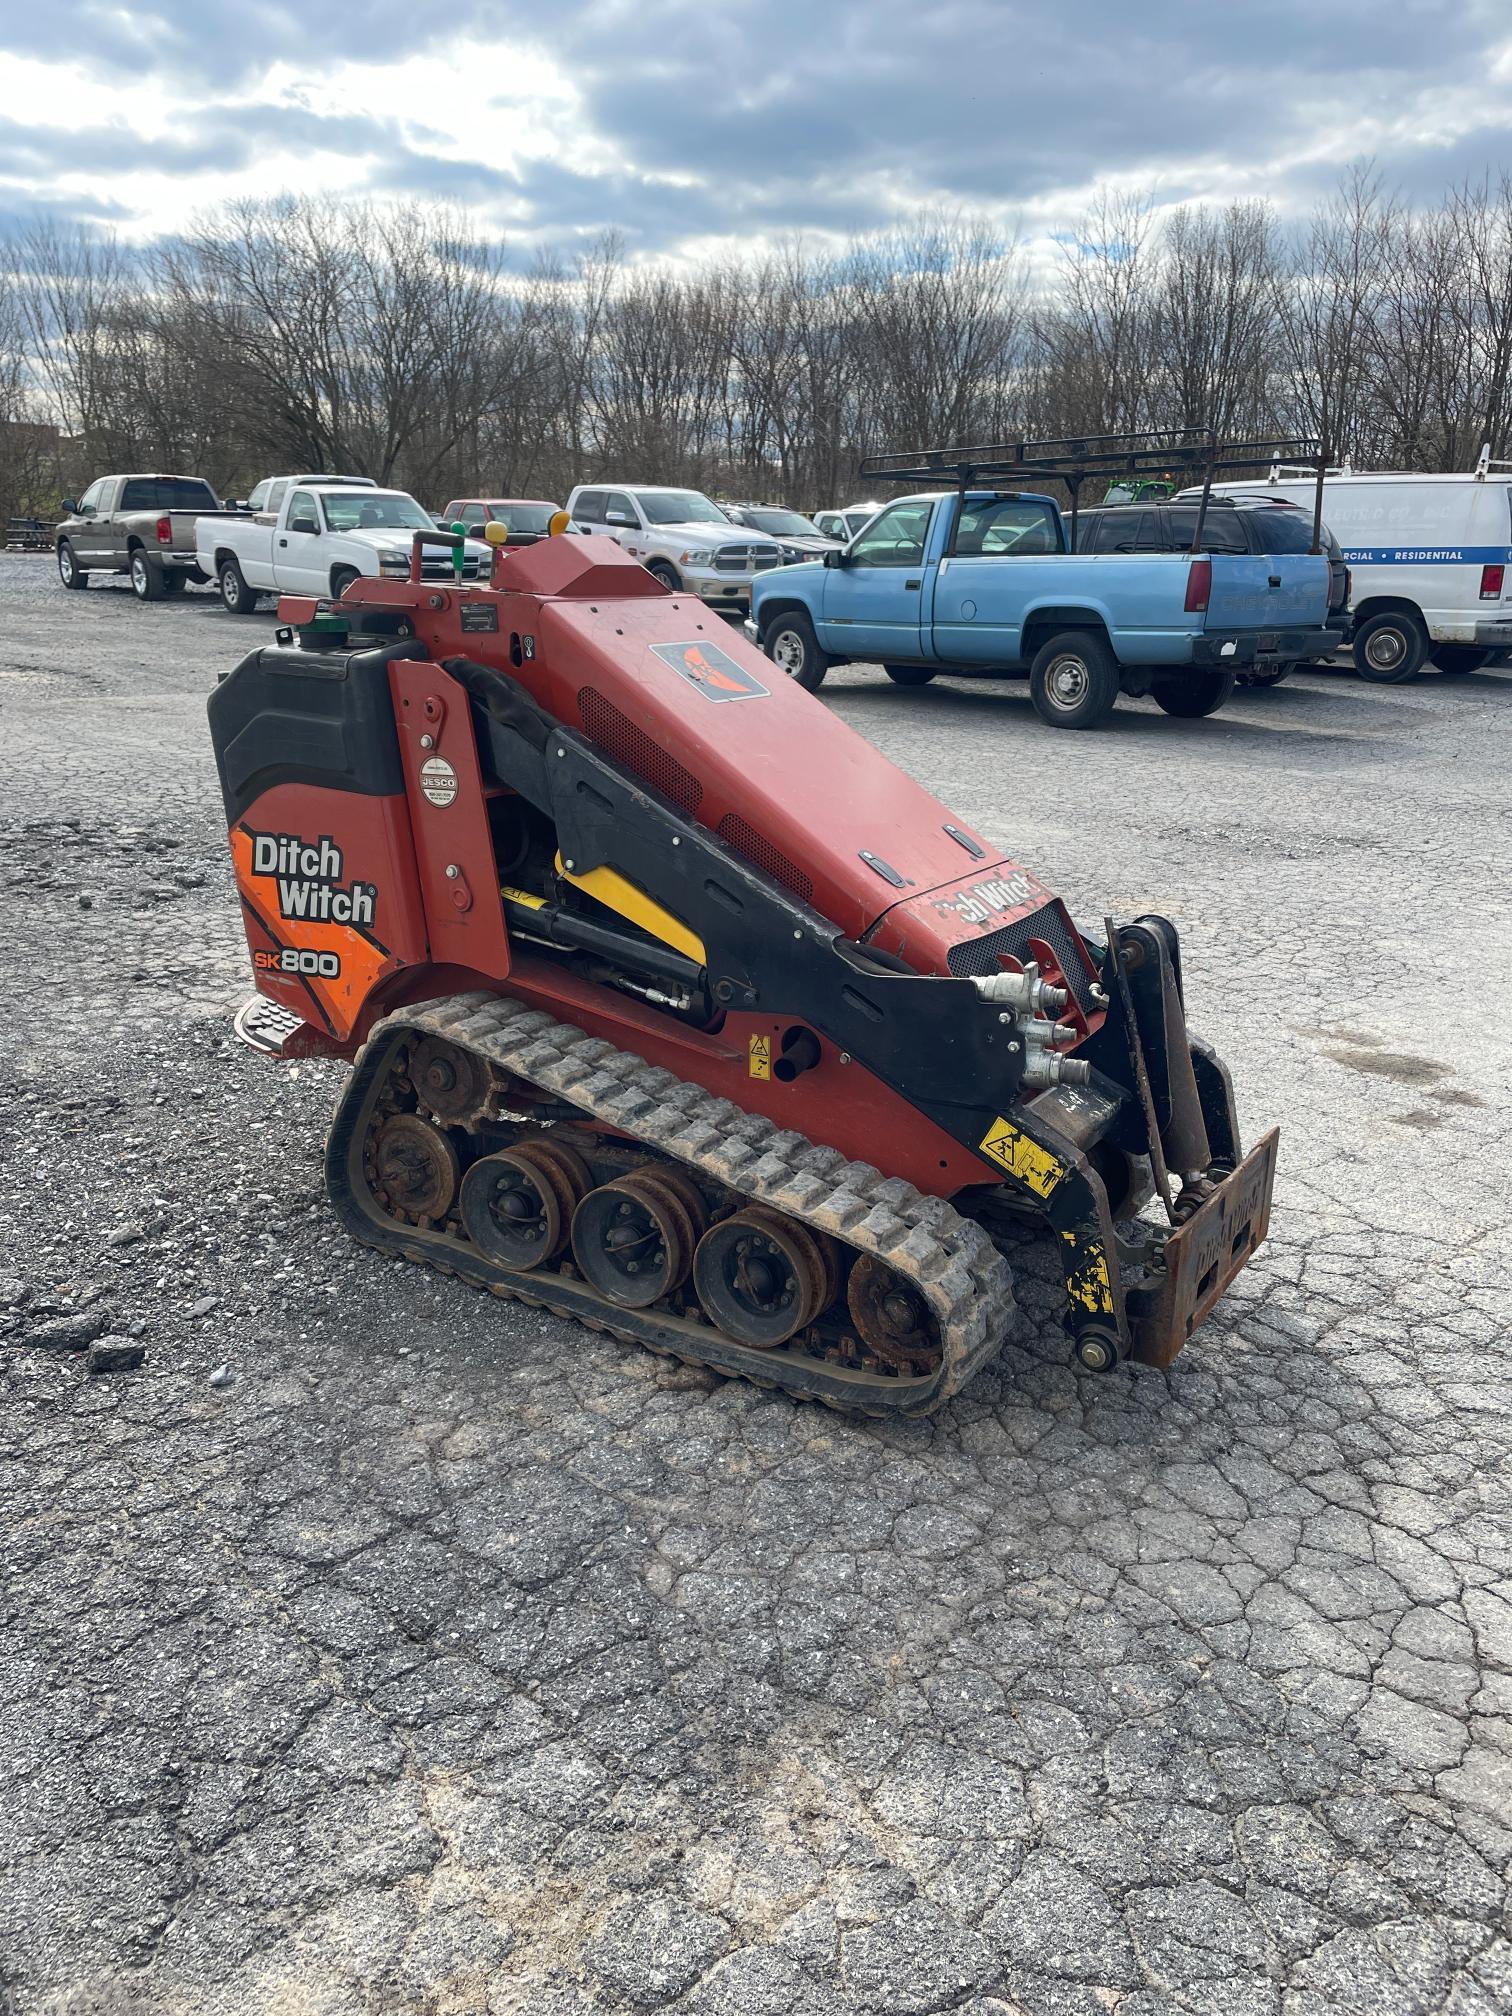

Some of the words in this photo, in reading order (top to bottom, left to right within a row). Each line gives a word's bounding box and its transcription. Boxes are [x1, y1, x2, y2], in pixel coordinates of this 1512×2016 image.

[1394, 551, 1463, 561] RESIDENTIAL
[422, 777, 456, 787] JESCO
[254, 836, 340, 878] Ditch
[279, 879, 373, 923] Witch
[254, 949, 339, 976] SK800
